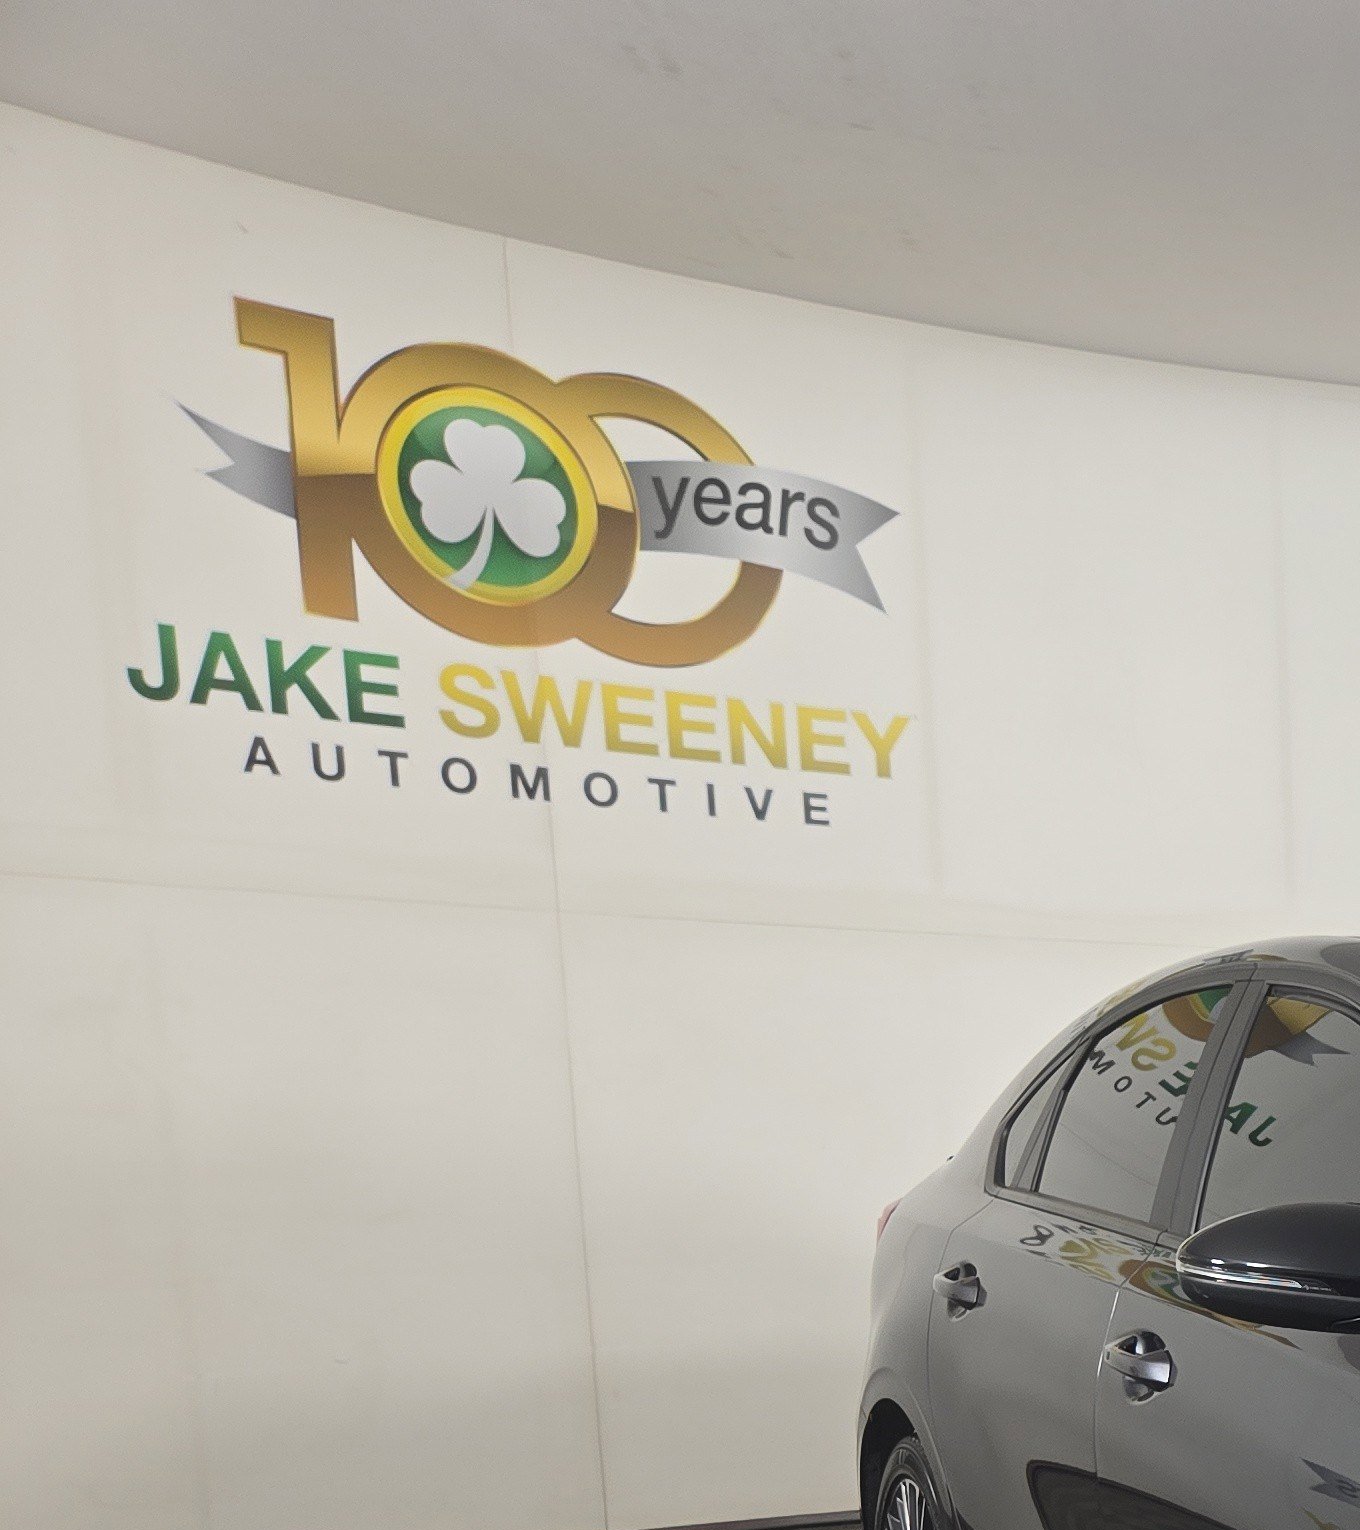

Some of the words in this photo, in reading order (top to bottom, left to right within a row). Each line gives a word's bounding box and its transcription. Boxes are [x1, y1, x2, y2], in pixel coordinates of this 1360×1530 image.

[233, 297, 784, 668] 100
[650, 473, 842, 552] years
[127, 621, 406, 730] JAKE
[438, 662, 911, 780] SWEENEY
[243, 736, 833, 828] AUTOMOTIVE
